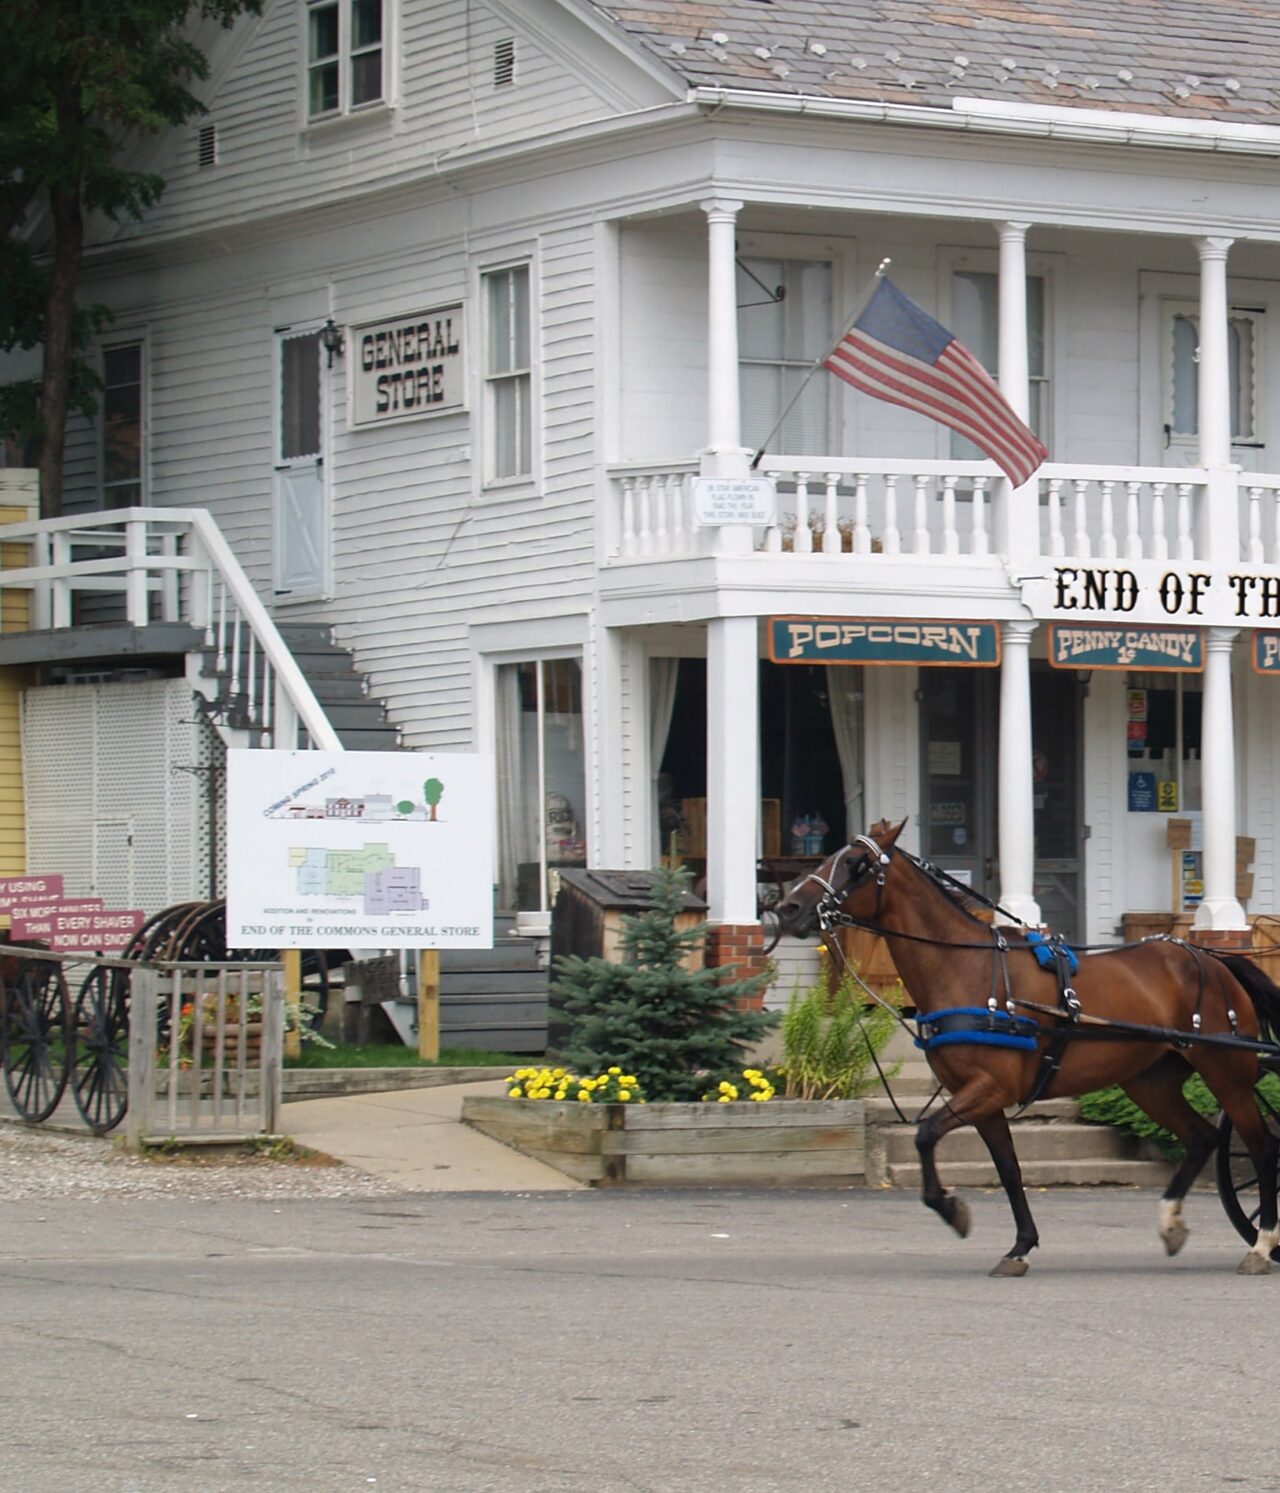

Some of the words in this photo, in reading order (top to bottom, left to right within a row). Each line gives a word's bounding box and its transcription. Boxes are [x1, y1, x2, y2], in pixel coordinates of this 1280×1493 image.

[362, 319, 459, 372] GENERAL
[376, 364, 444, 412] STORE
[1053, 567, 1140, 612] END
[1159, 572, 1212, 615] OF
[788, 624, 981, 660] POPCORN
[1057, 629, 1122, 662] PENNY
[1125, 631, 1196, 664] CANDY
[8, 880, 47, 893] USING
[12, 907, 29, 919] SIX
[24, 922, 51, 934] THAN
[57, 917, 92, 930] EVERY
[93, 915, 136, 929] SHAVER
[240, 925, 267, 935] END
[269, 925, 285, 935] OF
[288, 925, 314, 936] THE
[316, 925, 378, 936] COMMONS
[381, 926, 438, 936] GENERAL
[440, 926, 480, 936] STORE
[54, 935, 79, 947] NOW
[80, 933, 103, 946] CAN
[103, 933, 133, 946] SNOR
